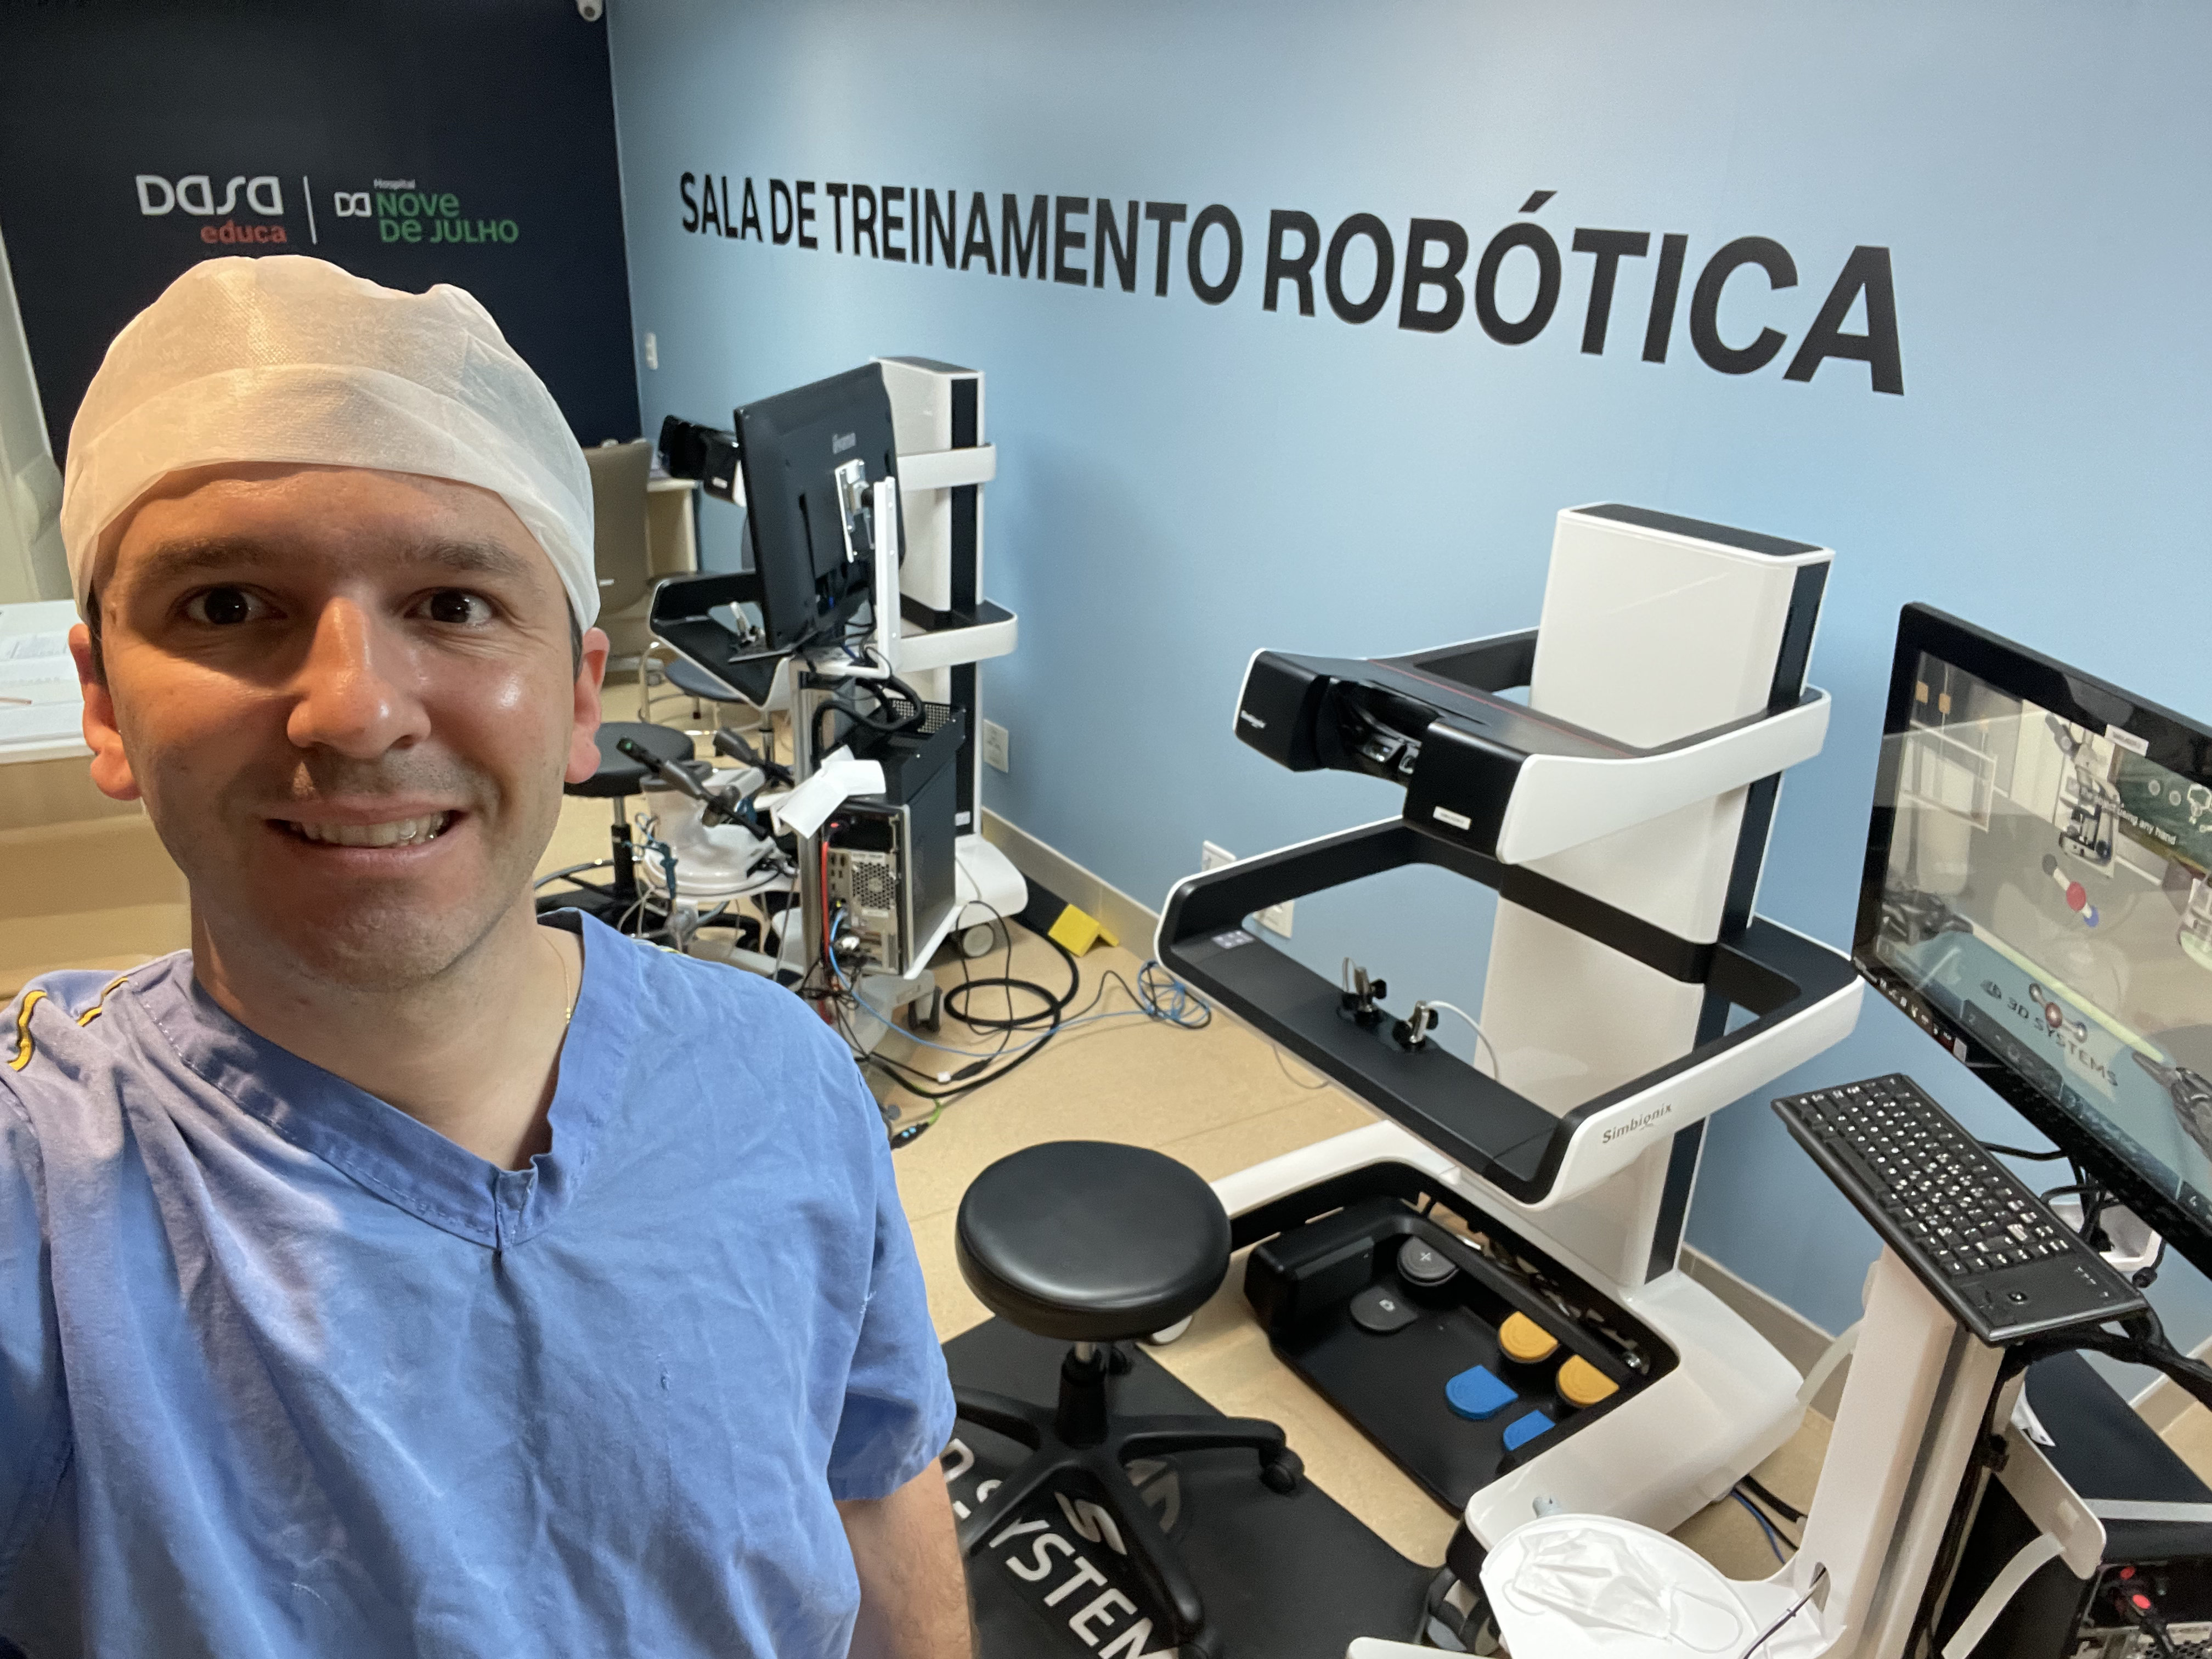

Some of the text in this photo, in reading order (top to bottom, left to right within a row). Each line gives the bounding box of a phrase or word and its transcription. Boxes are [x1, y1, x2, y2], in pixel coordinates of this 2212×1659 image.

[200, 220, 287, 244] educa
[430, 219, 519, 244] JULHO
[680, 171, 1905, 397] SALA DE TREINAMENTO ROBÓTICA
[2007, 996, 2029, 1019] 3D
[2033, 1017, 2119, 1087] SYSTEMS
[1602, 1102, 1672, 1144] Simbionix
